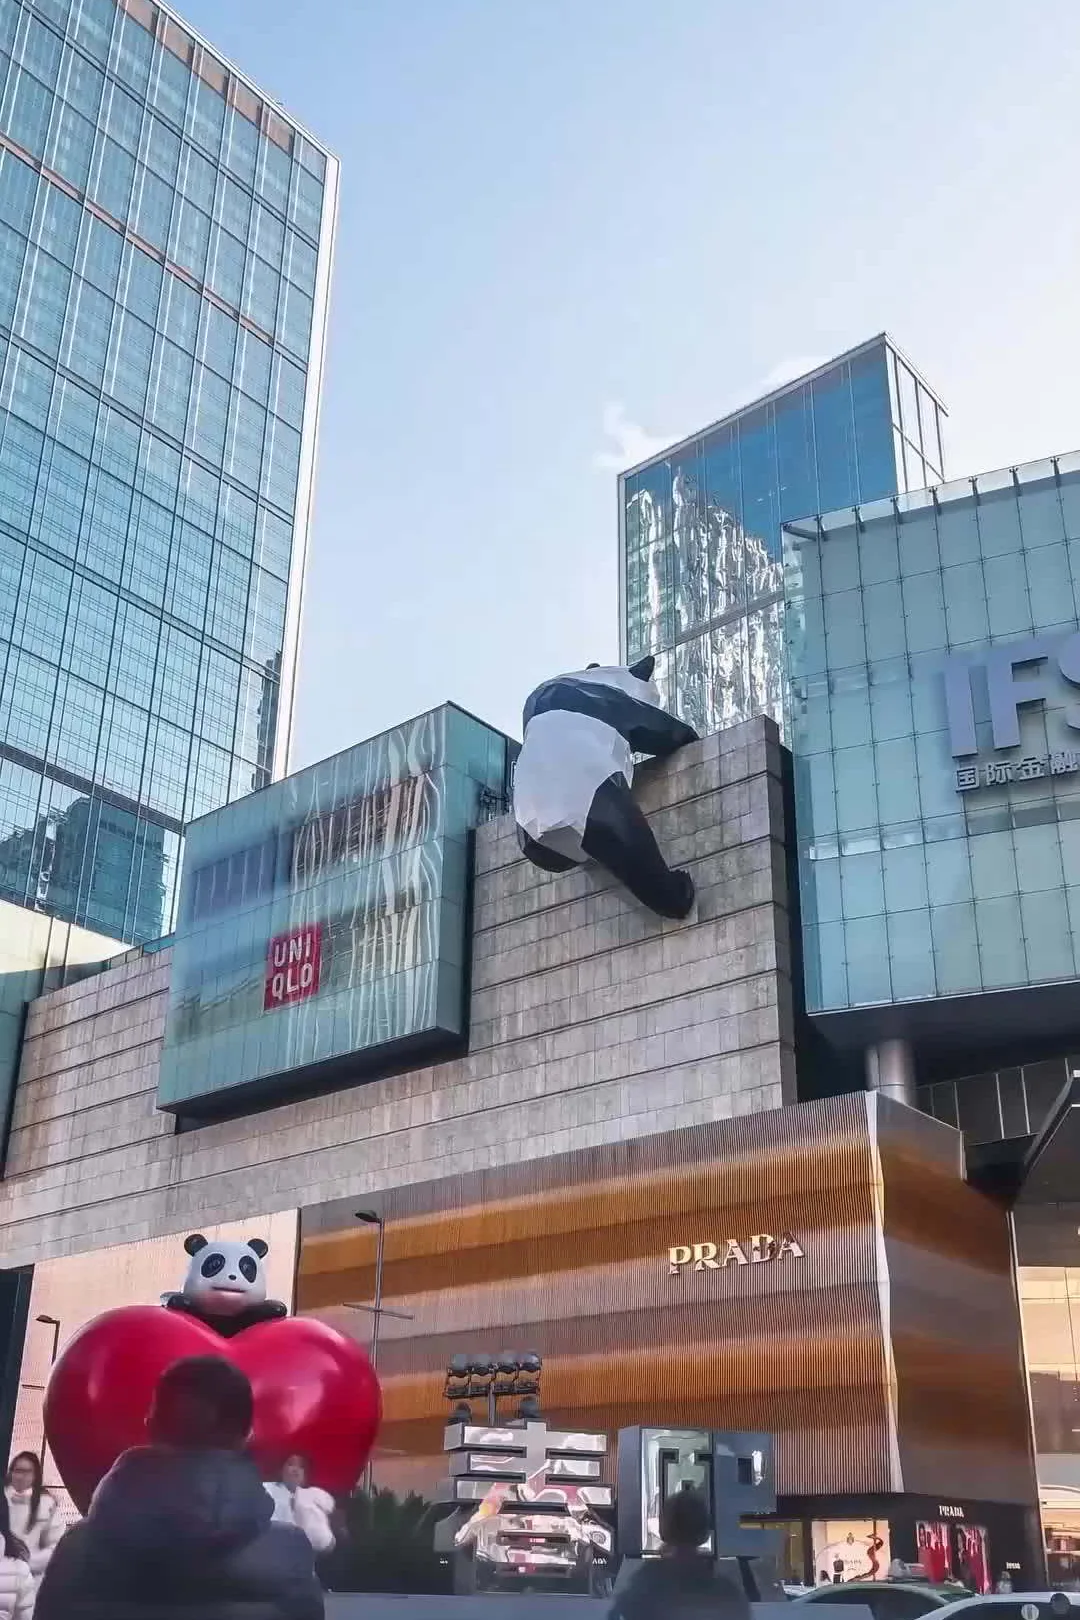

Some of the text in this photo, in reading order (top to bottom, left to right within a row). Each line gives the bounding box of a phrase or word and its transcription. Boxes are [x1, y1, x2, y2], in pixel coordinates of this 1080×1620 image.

[274, 933, 311, 968] UNI
[272, 962, 313, 1001] QLO
[668, 1231, 804, 1275] PRADA
[939, 1505, 965, 1518] PRADA
